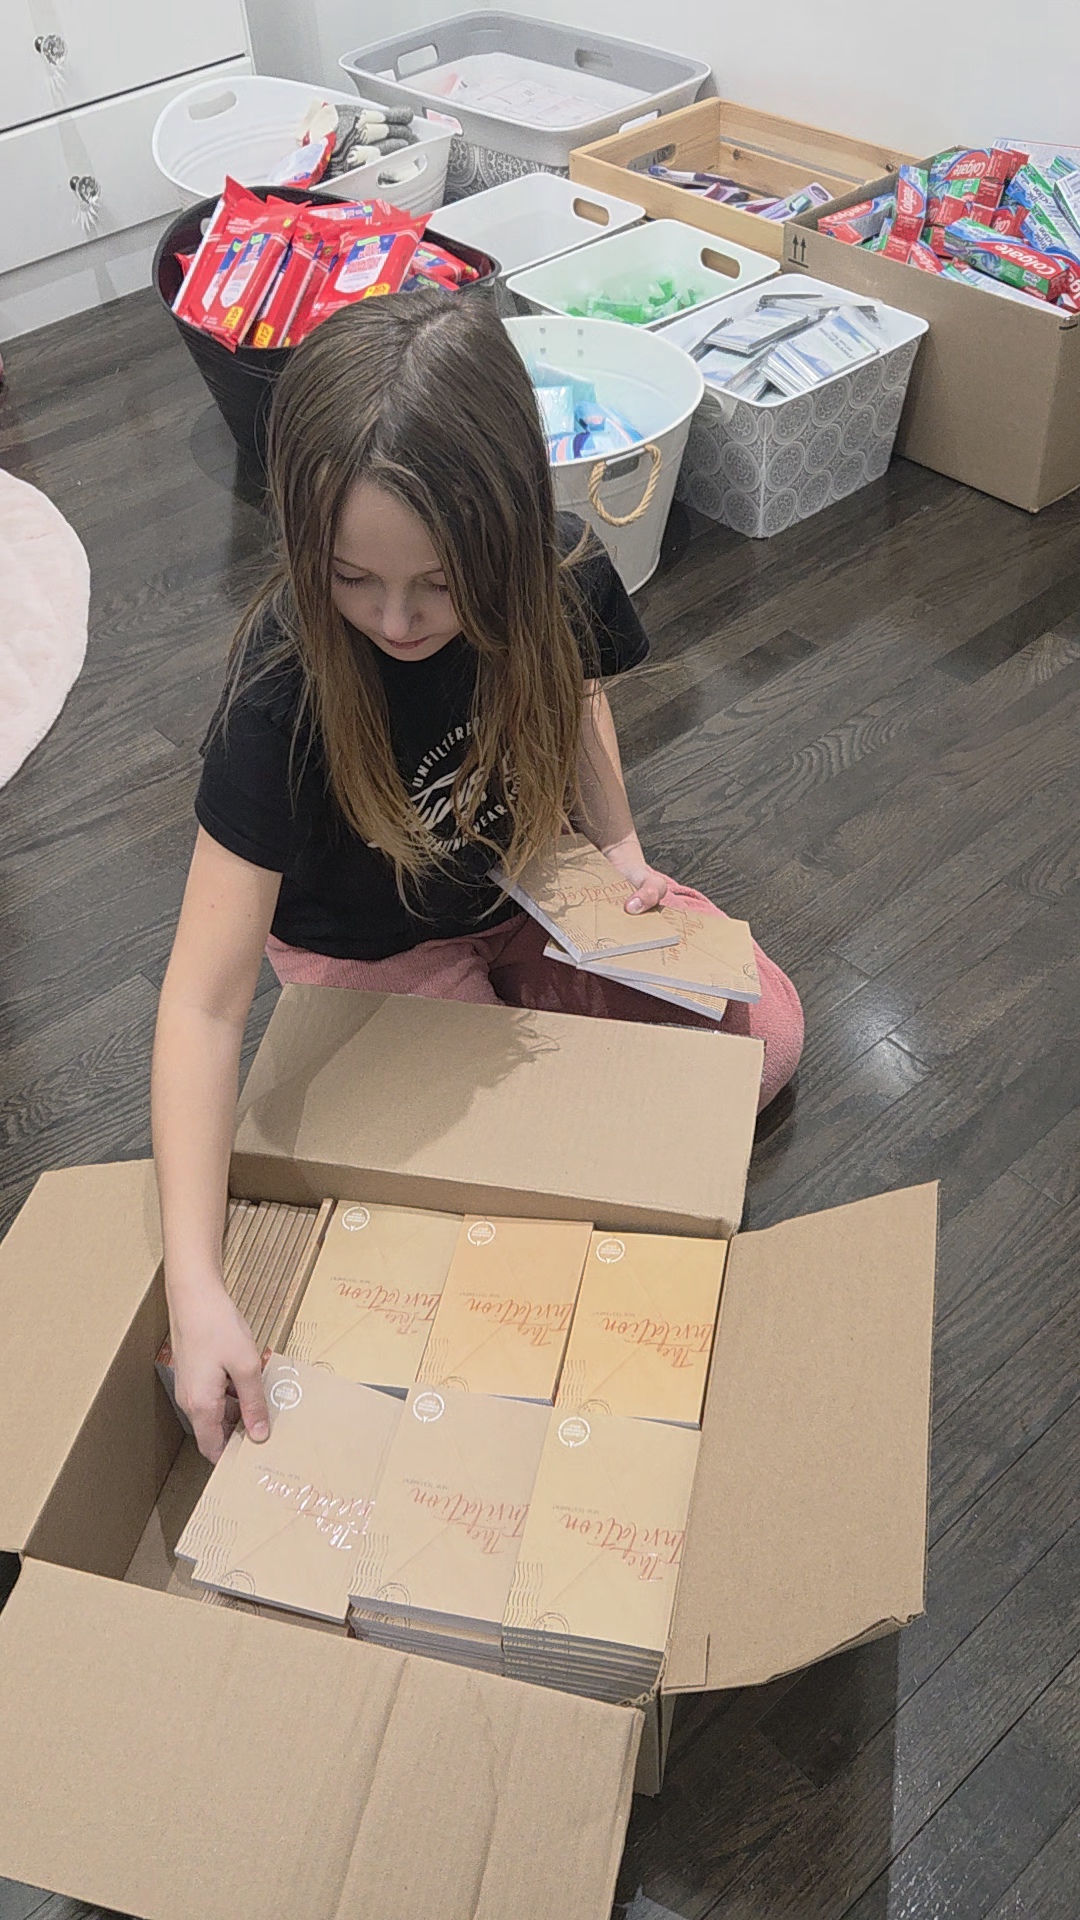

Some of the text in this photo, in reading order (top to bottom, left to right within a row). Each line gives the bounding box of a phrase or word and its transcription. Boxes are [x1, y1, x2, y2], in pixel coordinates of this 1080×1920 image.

[994, 244, 1057, 275] Colgate
[334, 1282, 443, 1321] Invitation
[463, 1298, 574, 1332] Invitation
[517, 1324, 552, 1347] The
[600, 1317, 714, 1352] Invitation
[656, 1345, 694, 1368] The
[410, 1486, 531, 1538] Invitation
[466, 1526, 504, 1555] The
[558, 1512, 687, 1565] Invitation
[621, 1551, 663, 1581] The
